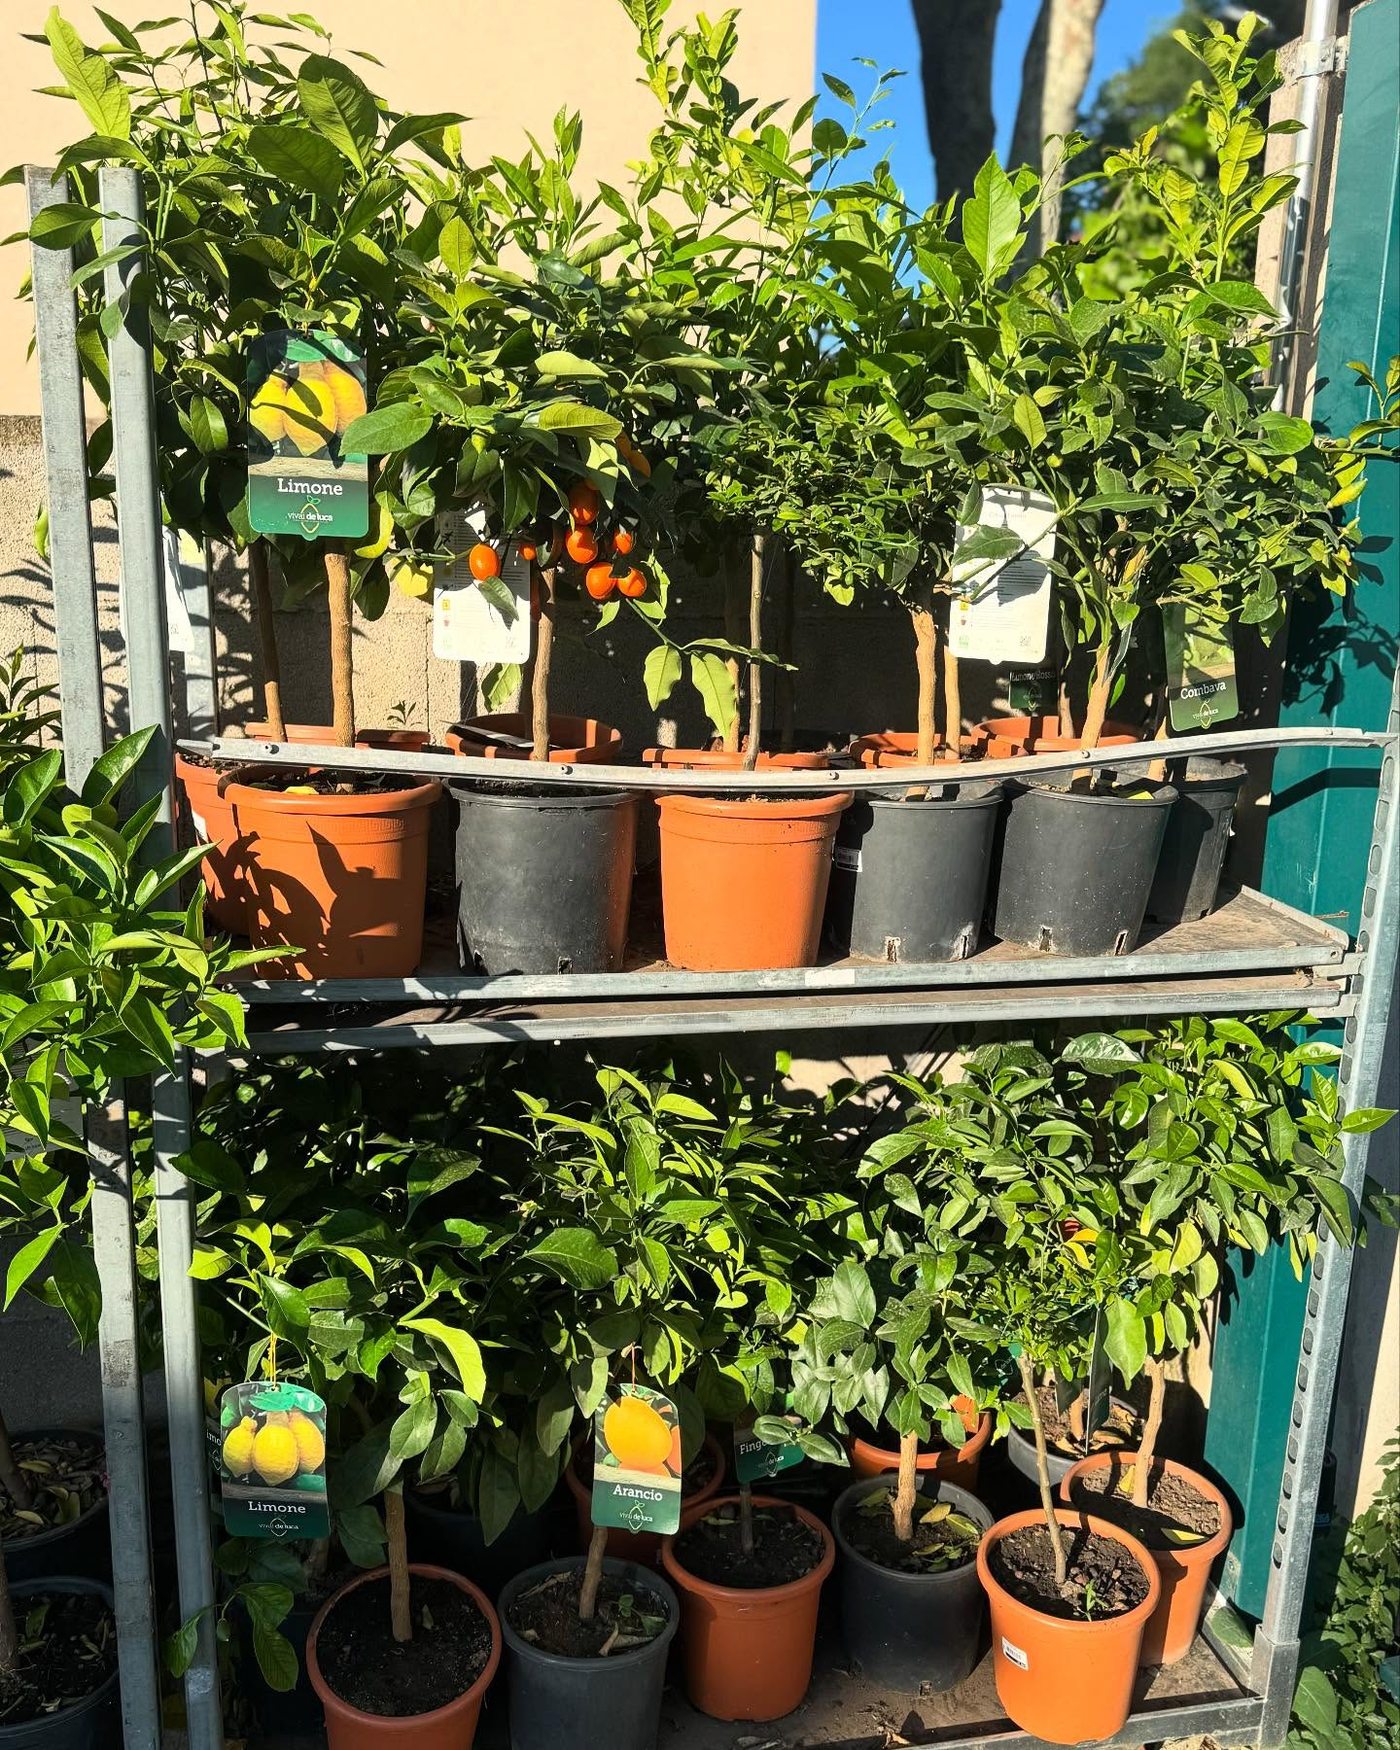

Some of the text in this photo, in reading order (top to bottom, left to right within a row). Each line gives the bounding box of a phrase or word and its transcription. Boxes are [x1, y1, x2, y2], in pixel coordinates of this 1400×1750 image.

[277, 478, 343, 495] Limone
[1180, 681, 1226, 699] Combava
[612, 1484, 663, 1501] Arancio
[248, 1501, 306, 1513] Limone
